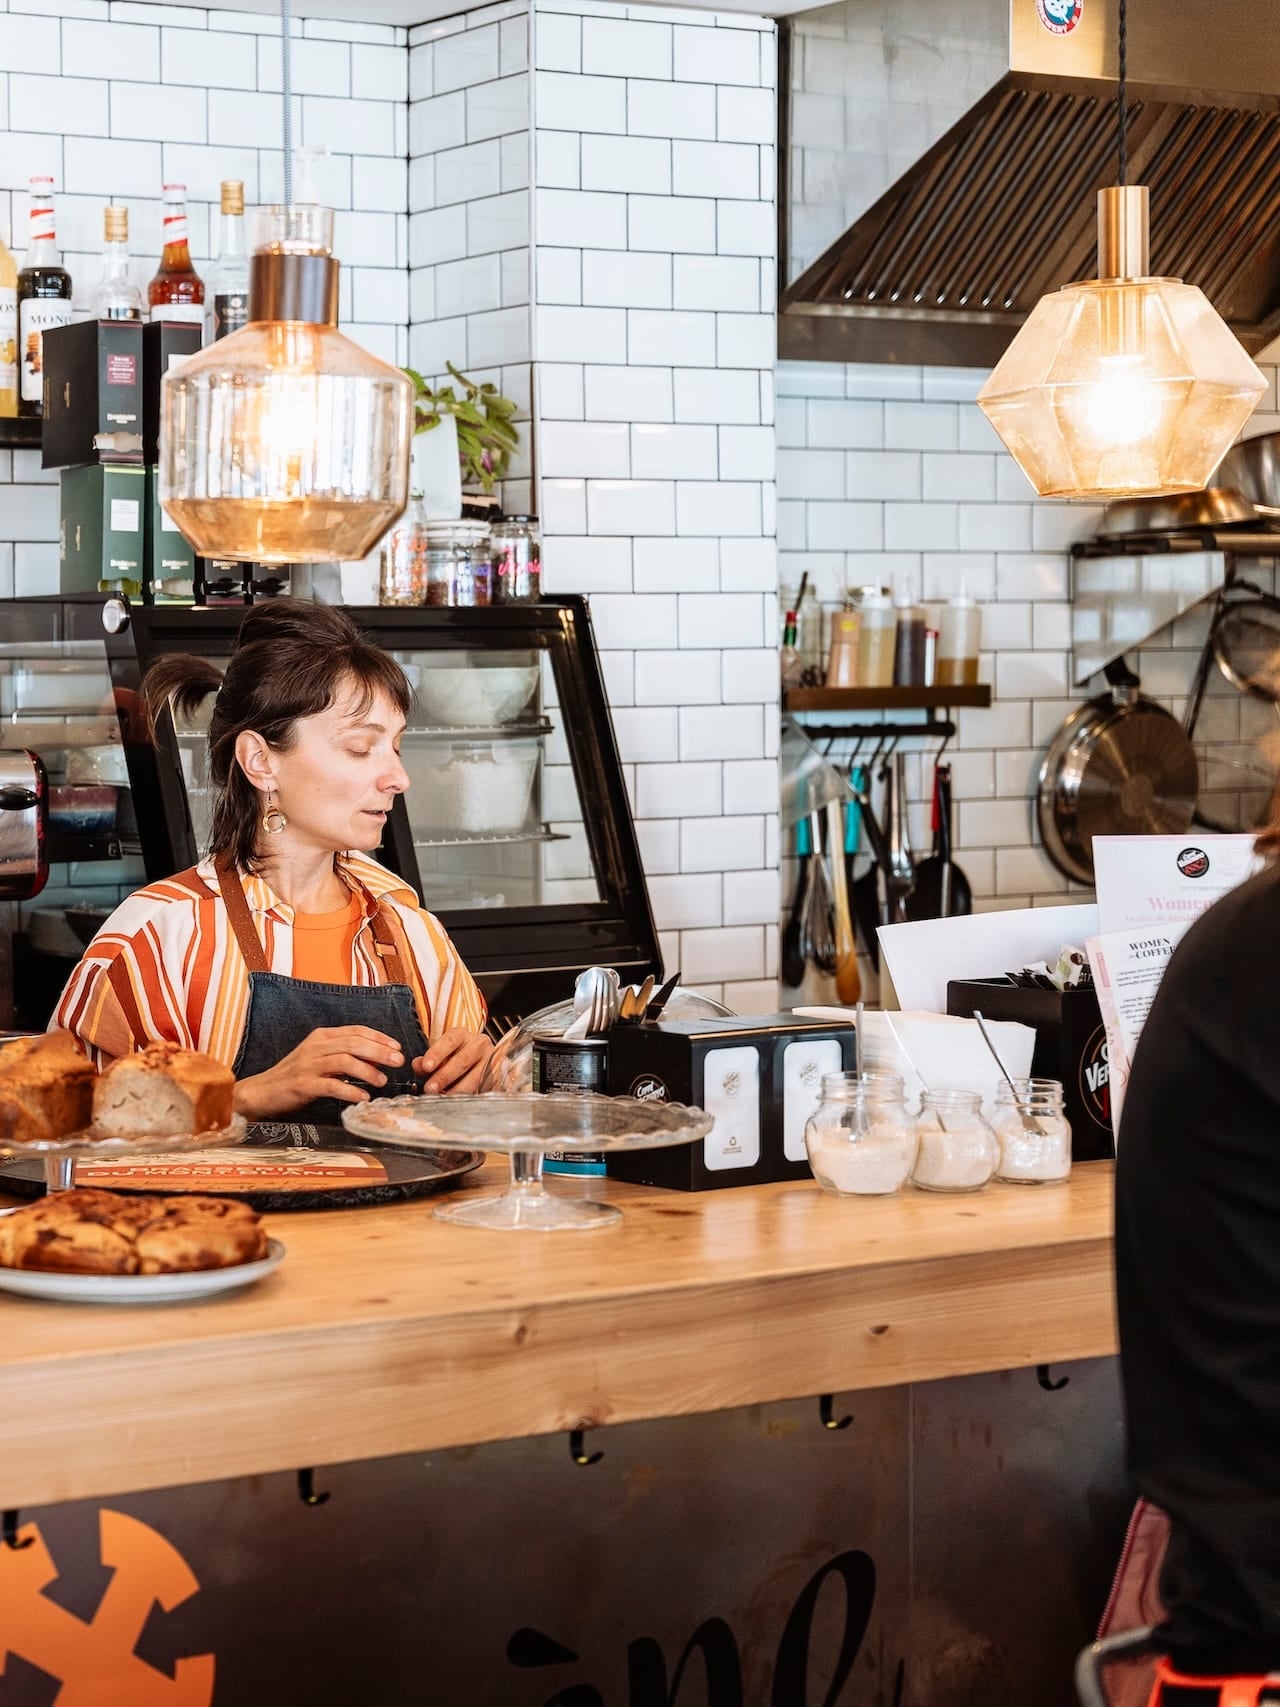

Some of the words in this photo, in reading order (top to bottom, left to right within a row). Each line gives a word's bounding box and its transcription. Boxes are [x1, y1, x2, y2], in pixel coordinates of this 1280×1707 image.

[1128, 937, 1172, 951] WOMEN
[87, 1170, 131, 1178] DU
[144, 1170, 236, 1178] MONT
[236, 1170, 347, 1178] BLANC
